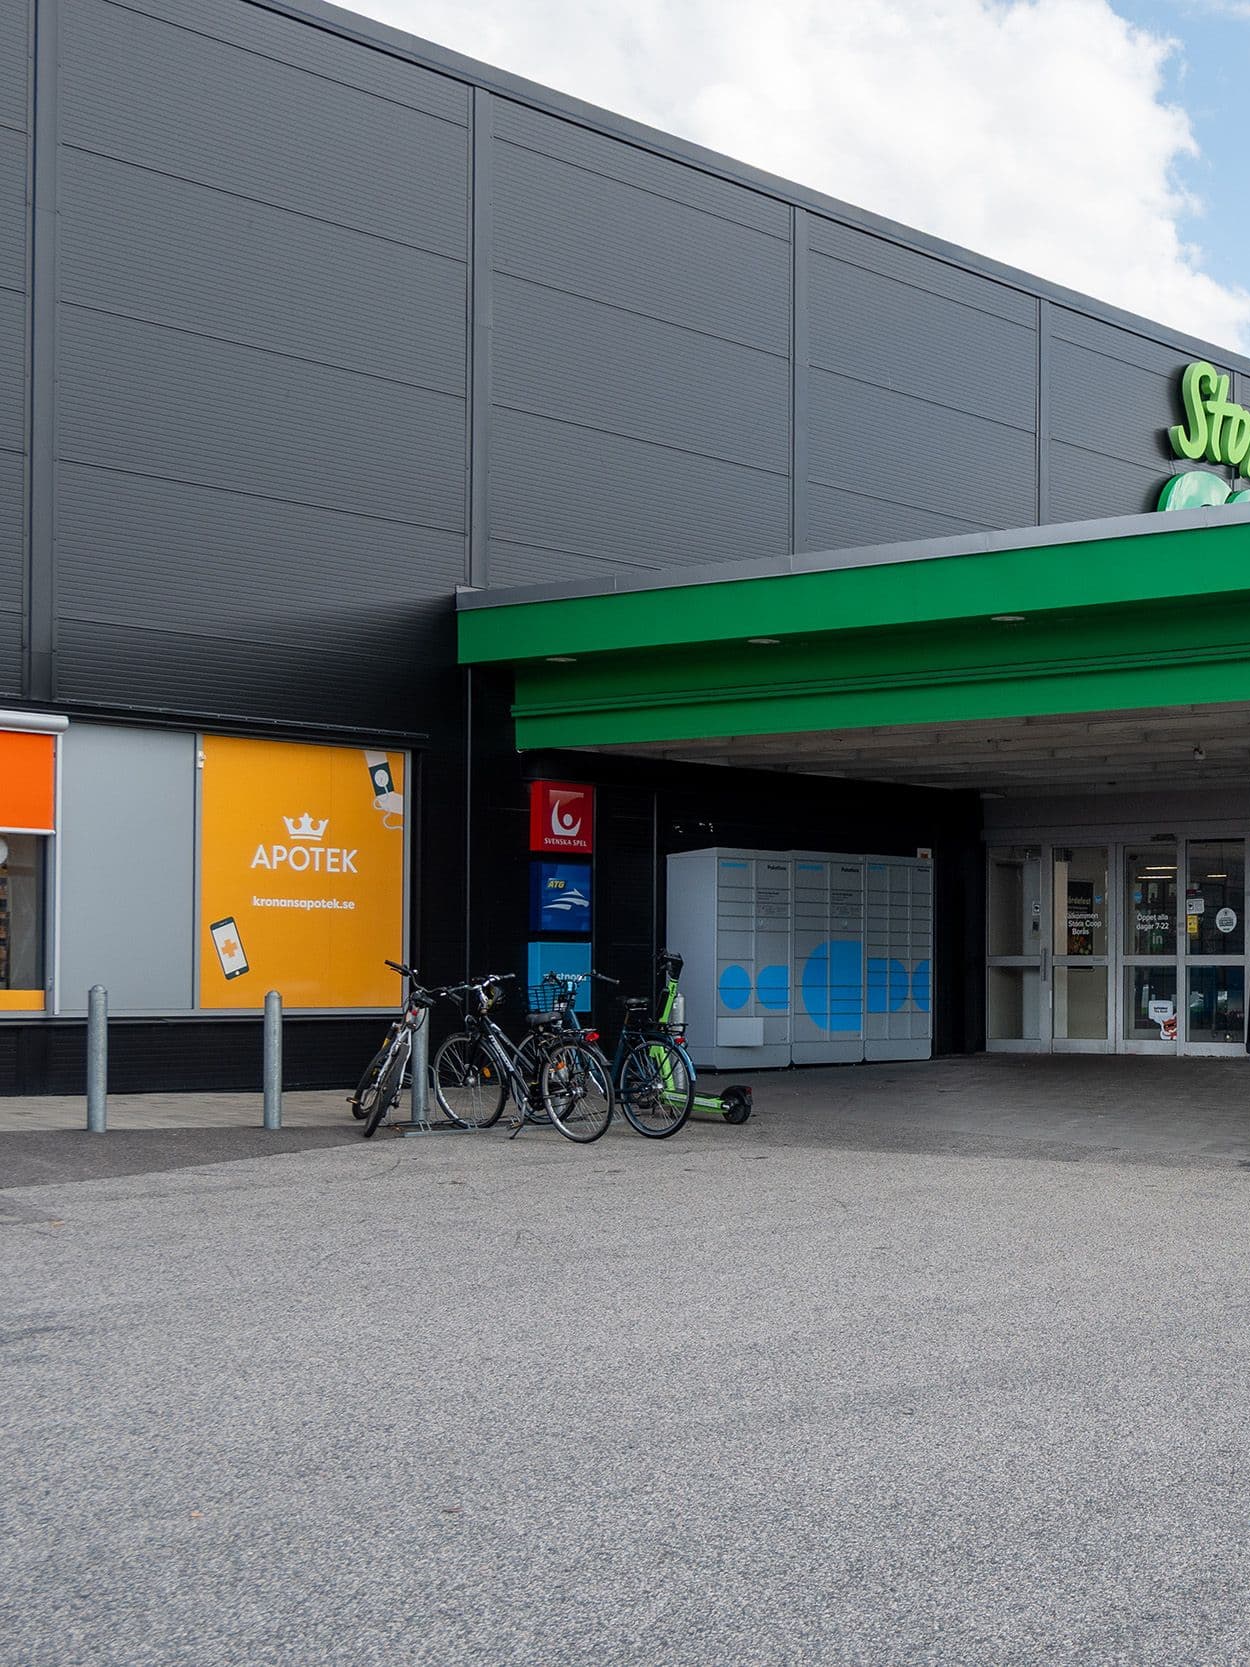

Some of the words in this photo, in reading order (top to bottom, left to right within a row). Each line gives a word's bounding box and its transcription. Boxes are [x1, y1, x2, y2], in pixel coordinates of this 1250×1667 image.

[544, 837, 571, 846] SVENSKA
[250, 844, 358, 873] APOTEK
[547, 880, 565, 889] ATG
[252, 896, 355, 911] kronansapotek.se
[1136, 912, 1157, 922] Öppet
[1085, 919, 1102, 928] Coop
[1136, 923, 1154, 932] dagar
[1155, 922, 1170, 930] 7-22
[543, 972, 588, 982] pstnor
